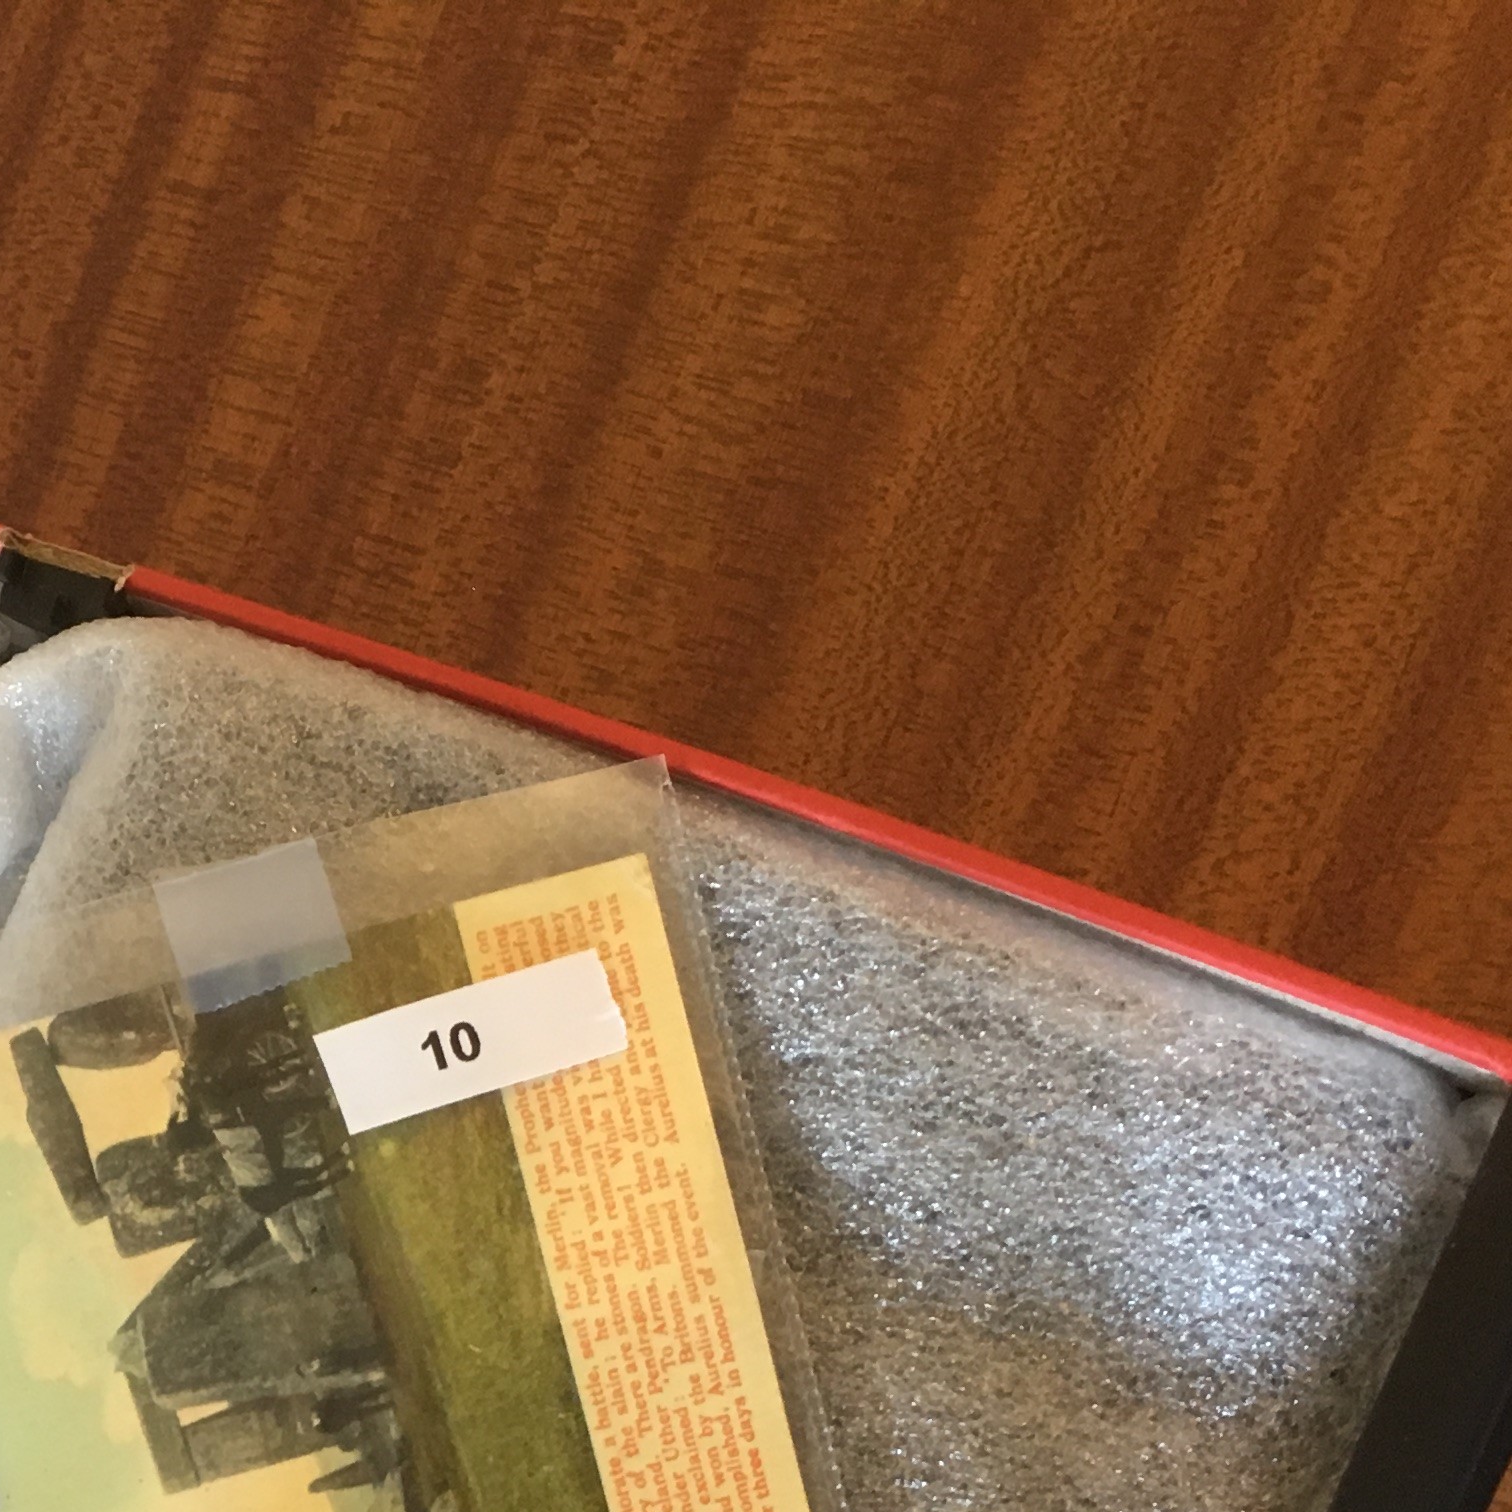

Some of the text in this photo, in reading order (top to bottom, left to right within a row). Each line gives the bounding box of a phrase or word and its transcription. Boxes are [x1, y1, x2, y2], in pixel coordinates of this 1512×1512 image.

[582, 898, 606, 934] the
[604, 891, 626, 934] was
[474, 928, 492, 954] on
[594, 939, 613, 962] to
[612, 941, 643, 999] death
[628, 1000, 651, 1034] his
[421, 1021, 481, 1070] 10
[638, 1035, 658, 1060] at
[508, 1080, 543, 1154] Prophe
[531, 1080, 556, 1132] want
[575, 1093, 596, 1134] was
[604, 1063, 639, 1144] directed
[630, 1082, 663, 1149] Clergy
[644, 1061, 680, 1147] Aurelius
[547, 1139, 570, 1175] you
[595, 1108, 625, 1167] While
[530, 1162, 552, 1196] the
[584, 1141, 619, 1221] removal
[626, 1150, 653, 1196] then
[648, 1155, 671, 1190] the
[670, 1161, 701, 1223] event.
[577, 1182, 600, 1226] vast
[539, 1201, 573, 1272] Merlin,
[590, 1229, 605, 1242] a
[606, 1227, 630, 1267] The
[639, 1202, 671, 1267] Merlin
[659, 1198, 702, 1305] summoned
[686, 1225, 710, 1260] the
[589, 1246, 611, 1270] of
[695, 1264, 718, 1288] of
[558, 1279, 582, 1310] for
[600, 1272, 629, 1337] stones
[639, 1276, 670, 1337] Arms,
[571, 1317, 594, 1360] sent
[589, 1316, 609, 1341] he
[620, 1282, 665, 1396] Pendragon.
[660, 1283, 696, 1365] Britons.
[703, 1292, 736, 1365] honour
[618, 1340, 638, 1374] are
[687, 1312, 725, 1399] Aurelius
[578, 1364, 614, 1430] battle,
[683, 1372, 706, 1406] the
[722, 1367, 743, 1390] in
[624, 1378, 655, 1438] There
[692, 1411, 716, 1440] by
[729, 1394, 759, 1444] days
[603, 1435, 617, 1448] a
[616, 1424, 640, 1459] the
[650, 1402, 680, 1462] Uther
[625, 1467, 647, 1491] of
[706, 1445, 728, 1488] won
[743, 1446, 771, 1500] three
